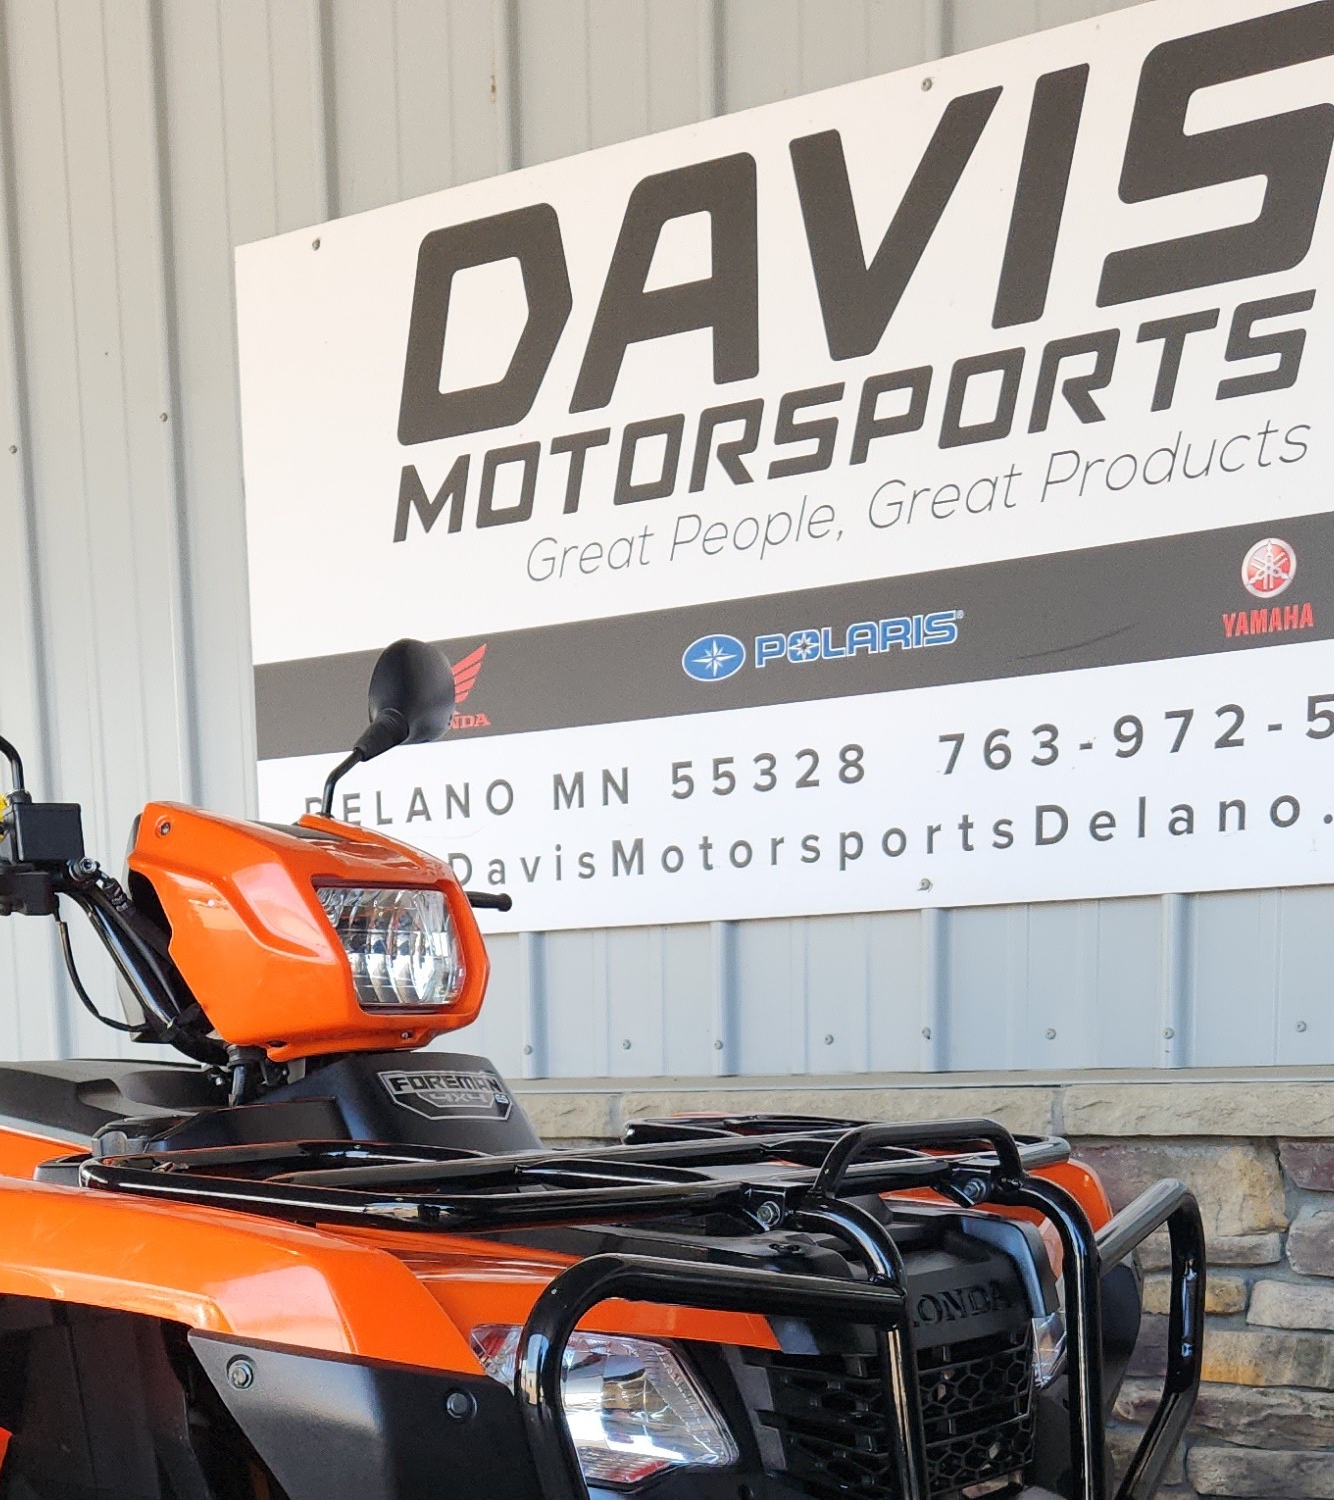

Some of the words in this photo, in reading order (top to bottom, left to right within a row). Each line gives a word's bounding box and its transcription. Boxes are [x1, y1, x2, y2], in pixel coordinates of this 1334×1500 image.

[393, 289, 1317, 543] MOTORSPORTS
[526, 524, 656, 583] Great
[669, 494, 847, 563] People,
[867, 462, 1024, 530] Great
[1039, 418, 1312, 504] Products
[754, 609, 959, 668] POLARIS
[1222, 602, 1313, 638] YAMAHA
[451, 711, 492, 730] NDA
[553, 766, 629, 811] MN
[672, 743, 866, 801] 55328
[388, 1074, 503, 1093] FOREMAN
[913, 1280, 1013, 1328] ONDA
